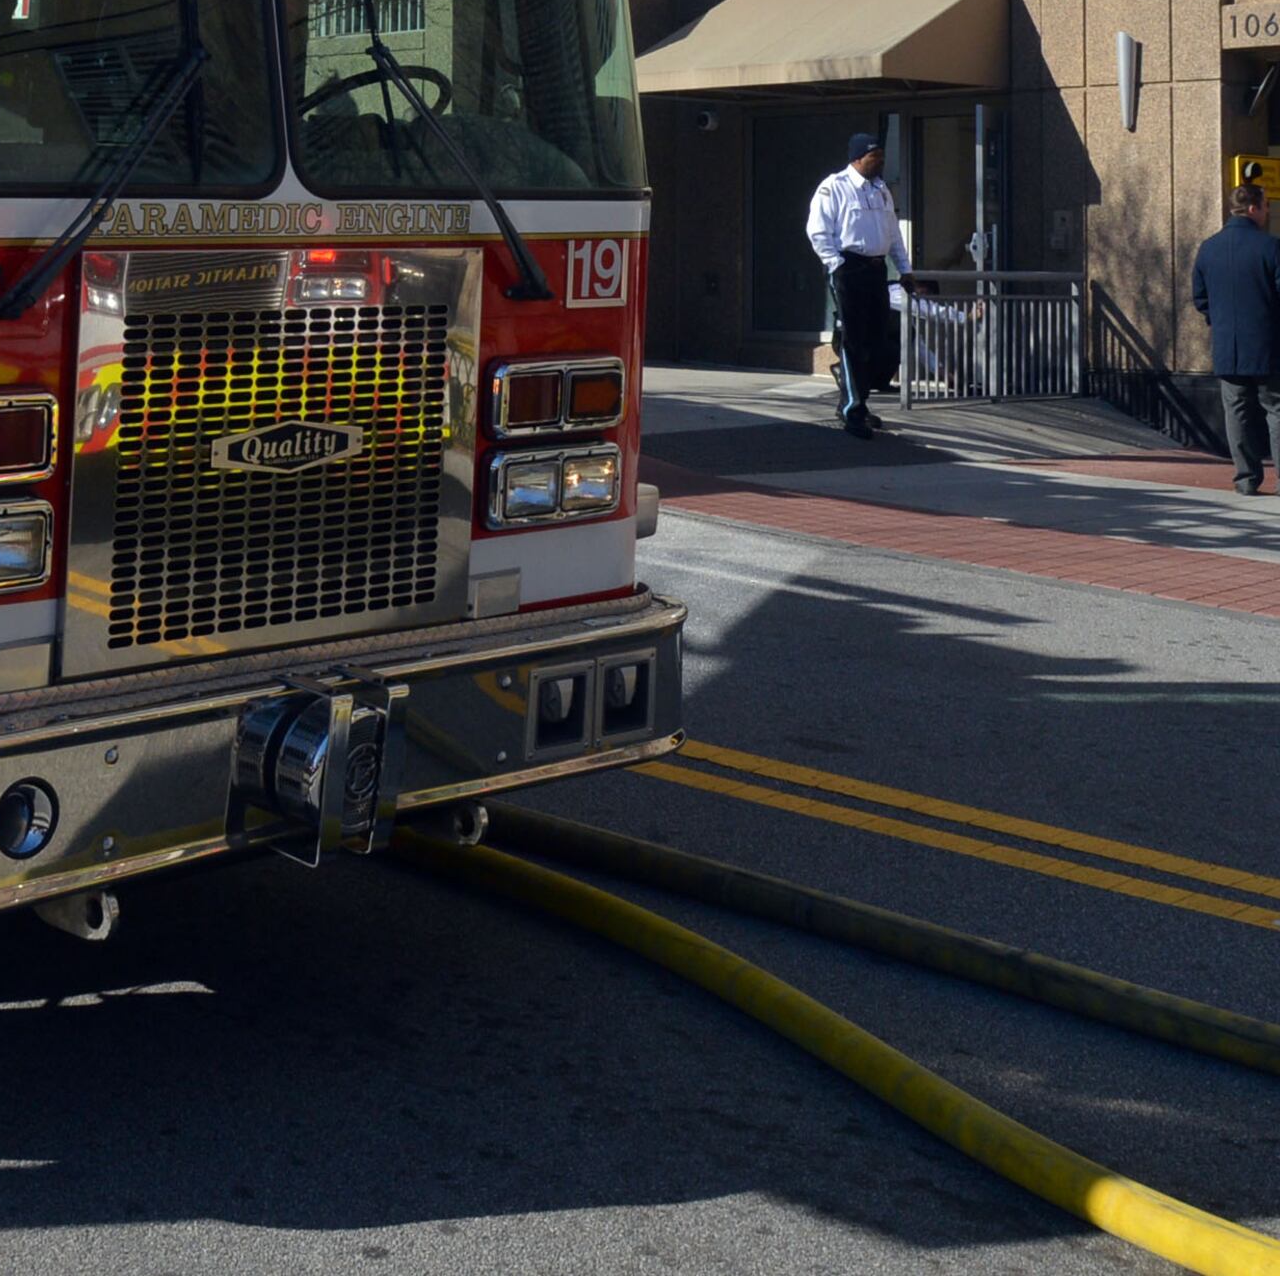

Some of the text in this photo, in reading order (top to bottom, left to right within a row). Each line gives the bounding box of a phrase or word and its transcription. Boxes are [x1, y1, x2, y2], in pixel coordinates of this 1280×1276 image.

[89, 202, 472, 236] PARAMEDIC ENGINE
[574, 239, 622, 298] 19
[241, 430, 337, 465] Quality
